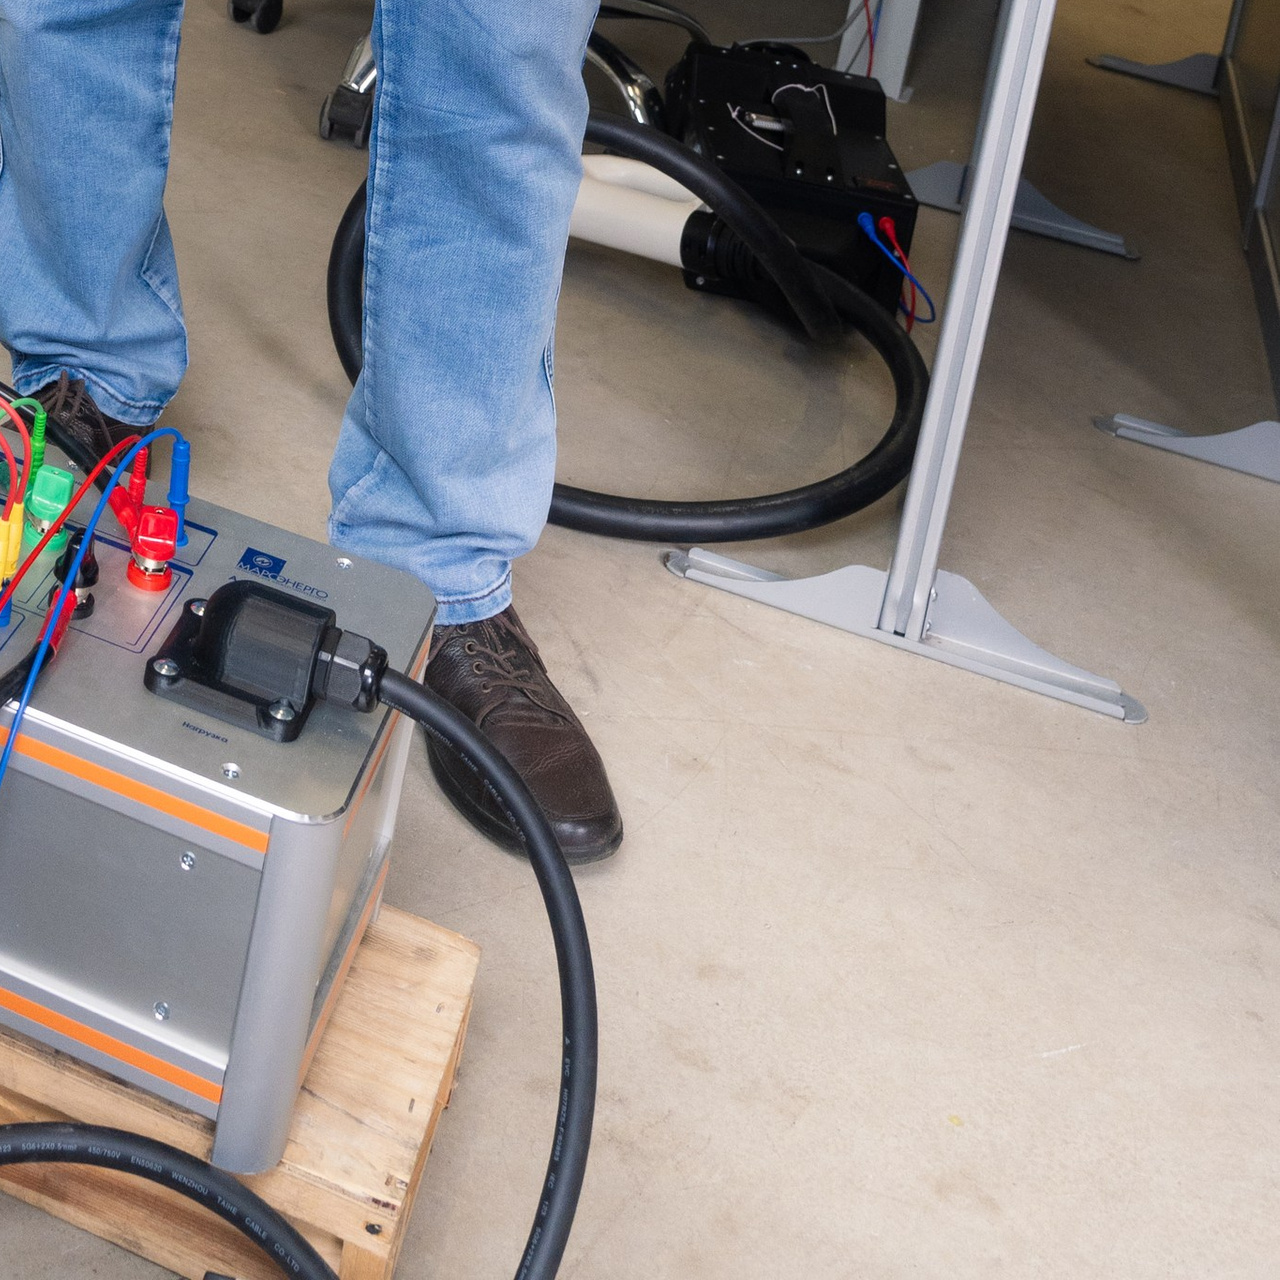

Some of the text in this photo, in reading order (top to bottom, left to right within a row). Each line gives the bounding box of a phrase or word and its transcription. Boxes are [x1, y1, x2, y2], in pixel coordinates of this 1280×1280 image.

[237, 561, 329, 599] МАРСЭНЕРГО
[182, 721, 228, 743] Нагрузка
[0, 1144, 12, 1153] 123
[171, 1170, 209, 1195] WENZHOU
[217, 1196, 238, 1216] TAIHE
[245, 1217, 268, 1240] CABLE
